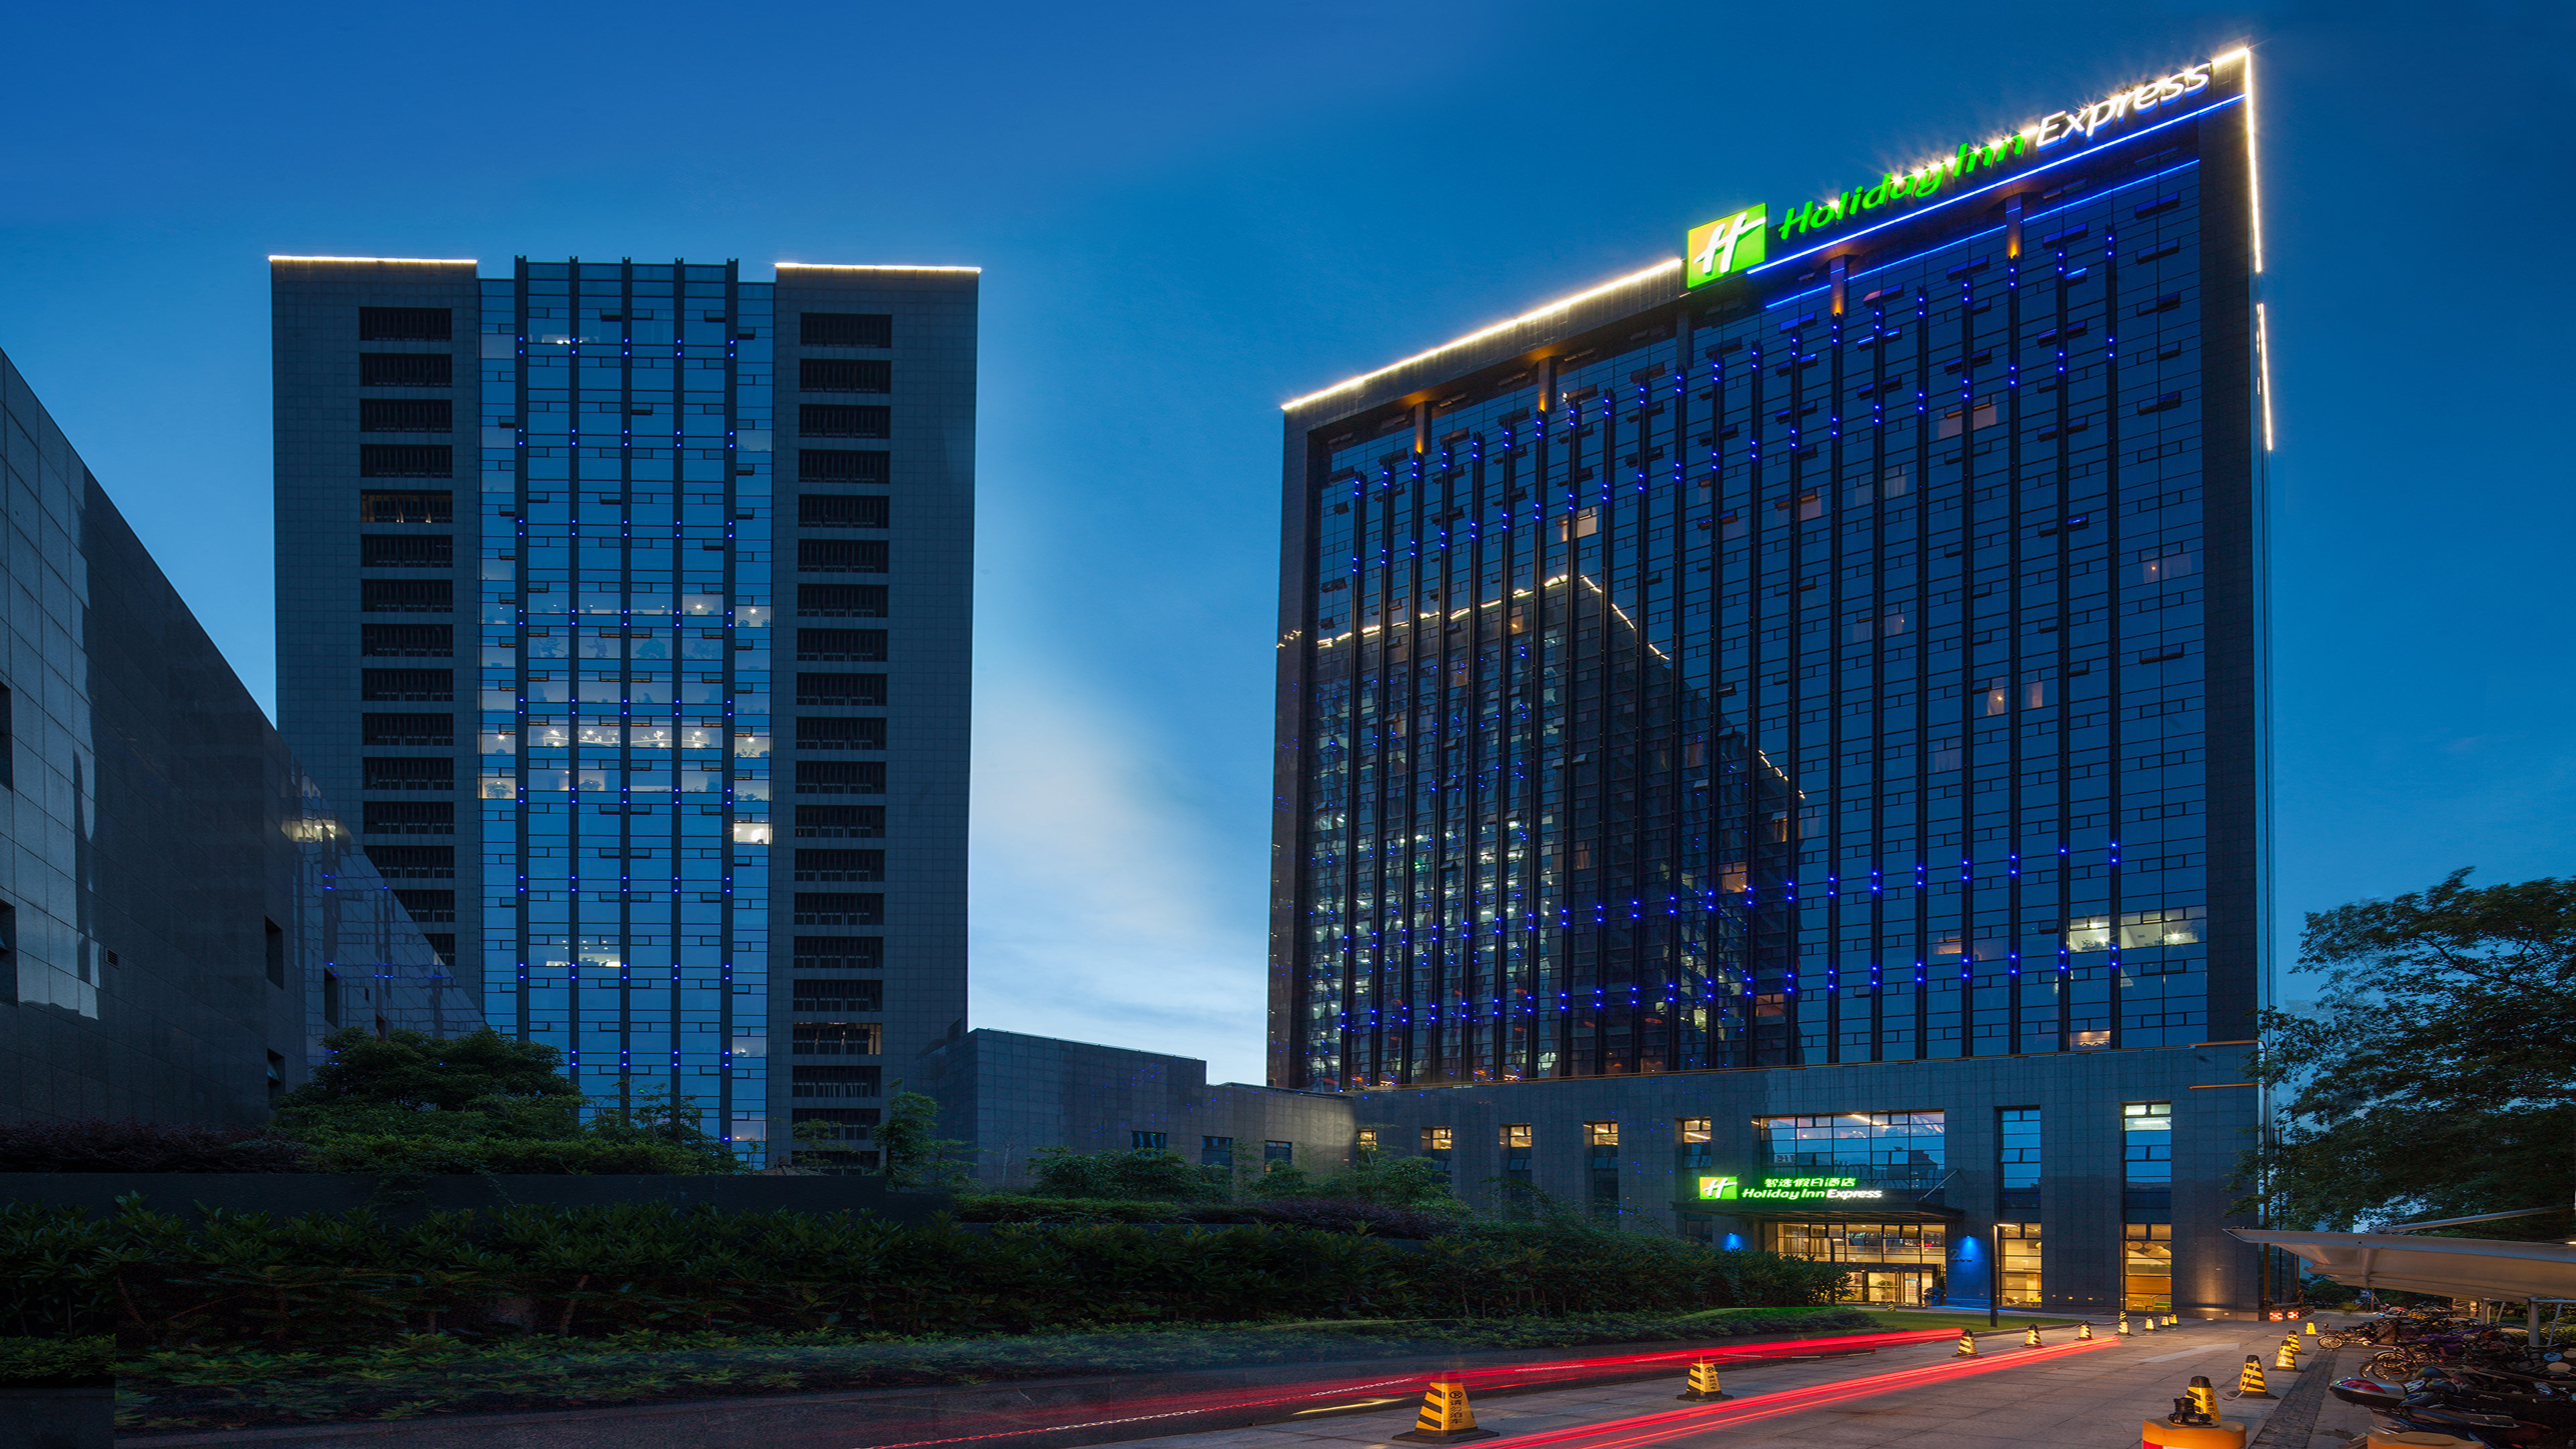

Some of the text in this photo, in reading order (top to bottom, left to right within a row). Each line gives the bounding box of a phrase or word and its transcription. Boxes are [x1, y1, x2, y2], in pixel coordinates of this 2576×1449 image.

[1778, 62, 2211, 240] Holiday Inn Express
[1765, 1178, 1856, 1187] 智选假日酒店
[1741, 1188, 1882, 1200] Holiday Inn Express
[1450, 1400, 1462, 1424] 请勿泊车
